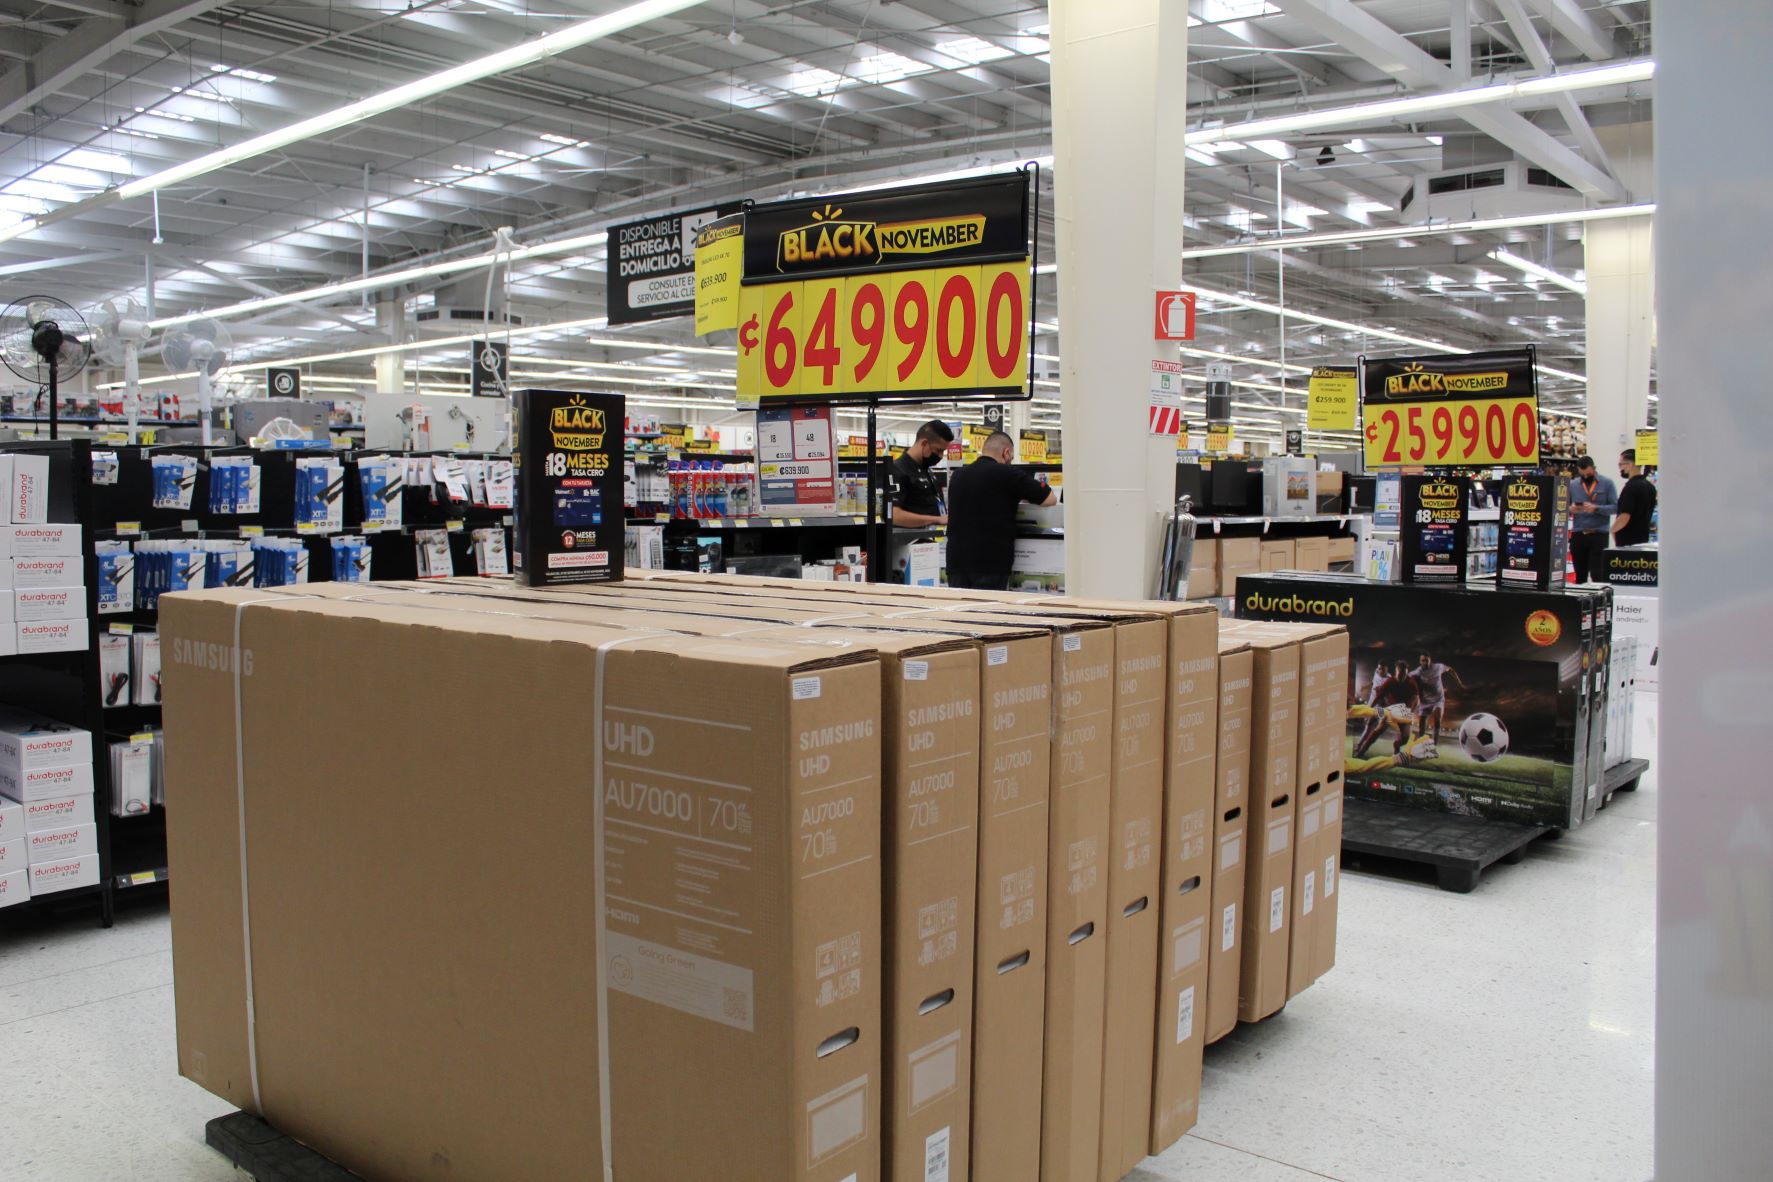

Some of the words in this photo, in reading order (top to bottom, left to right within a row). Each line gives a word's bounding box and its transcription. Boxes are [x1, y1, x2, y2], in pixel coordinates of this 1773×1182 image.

[620, 218, 680, 243] DISPONIBLE
[620, 237, 671, 259] ENTREGA
[672, 235, 680, 250] A
[784, 223, 874, 263] BLACK
[881, 222, 979, 250] NOVEMBER
[620, 256, 680, 277] DOMICILIO
[648, 278, 686, 291] CONSULTE
[637, 290, 669, 304] SERVICIO
[670, 288, 680, 299] AL
[680, 286, 696, 298] CLIE
[1152, 360, 1182, 372] EXTINTOR
[1388, 374, 1442, 394] BLACK
[1447, 376, 1504, 390] NOVEMBER
[554, 409, 602, 429] BLACK
[556, 436, 600, 448] NOVEMBER
[549, 452, 567, 476] 18
[567, 453, 609, 469] MESES
[571, 469, 587, 477] TASA
[587, 469, 604, 477] CERO
[18, 474, 28, 519] durabrand
[1422, 486, 1457, 496] BLACK
[1509, 486, 1536, 497] BLACK
[312, 510, 326, 518] XTC
[370, 508, 385, 516] XTC
[1419, 510, 1432, 523] 18
[1432, 510, 1460, 519] MESES
[1505, 511, 1514, 526] 18
[1514, 512, 1541, 522] MESES
[15, 529, 62, 537] durabrand
[564, 536, 573, 544] 12
[1372, 550, 1390, 560] PLAN
[1370, 560, 1388, 580] 0%
[1609, 572, 1657, 582] androidtv
[20, 592, 67, 601] durabrand
[1246, 592, 1354, 618] durabrand
[1616, 605, 1642, 614] Haier
[22, 625, 69, 633] durabrand
[1540, 616, 1546, 626] 2
[1121, 655, 1161, 675] SAMSUNG
[1180, 656, 1215, 676] SAMSUNG
[1063, 664, 1108, 686] SAMSUNG
[1120, 678, 1138, 695] UHD
[1178, 680, 1194, 695] UHD
[1224, 678, 1250, 692] SAMSUNG
[994, 684, 1048, 708] SAMSUNG
[1063, 690, 1082, 708] UHD
[908, 700, 972, 726] SAMSUNG
[994, 712, 1015, 731] UHD
[604, 720, 654, 757] UHD
[800, 719, 872, 750] SAMSUNG
[908, 731, 935, 752] UHD
[1062, 726, 1096, 747] AU7000
[26, 740, 72, 751] durabrand
[800, 755, 830, 778] UHD
[994, 750, 1032, 774] AU7000
[27, 769, 73, 781] durabrand
[908, 772, 954, 798] AU7000
[29, 800, 75, 813] durabrand
[605, 778, 692, 822] AU7000
[800, 797, 854, 828] AU7000
[32, 831, 78, 844] durabrand
[35, 862, 81, 876] durabrand
